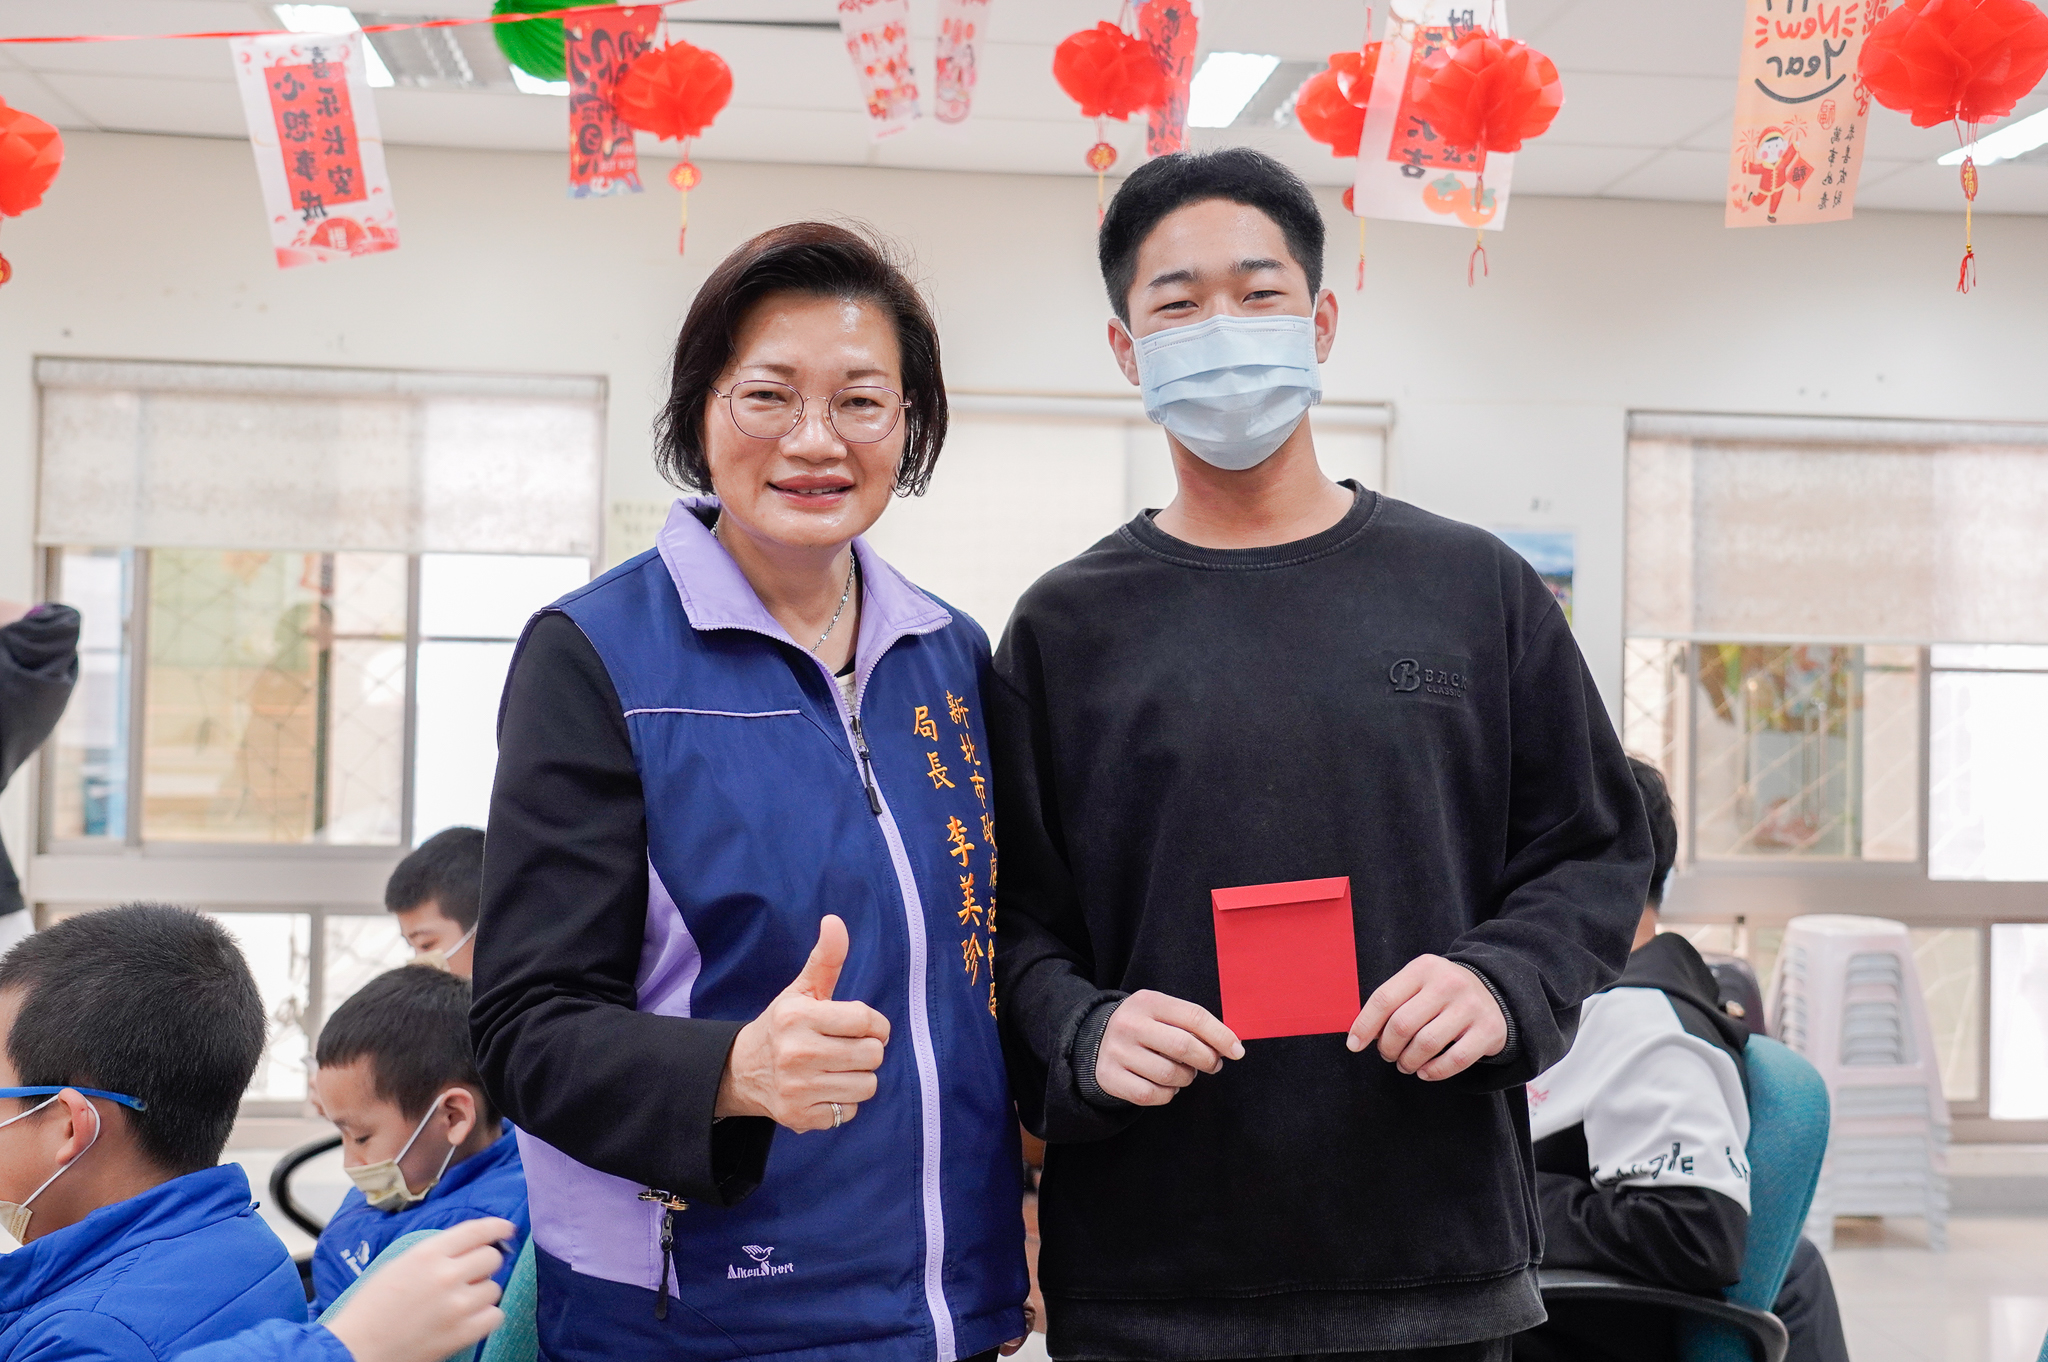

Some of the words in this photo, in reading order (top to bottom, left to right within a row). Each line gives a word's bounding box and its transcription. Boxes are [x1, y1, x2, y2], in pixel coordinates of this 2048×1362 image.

[913, 705, 956, 790] 局長
[946, 815, 984, 987] 李美珍
